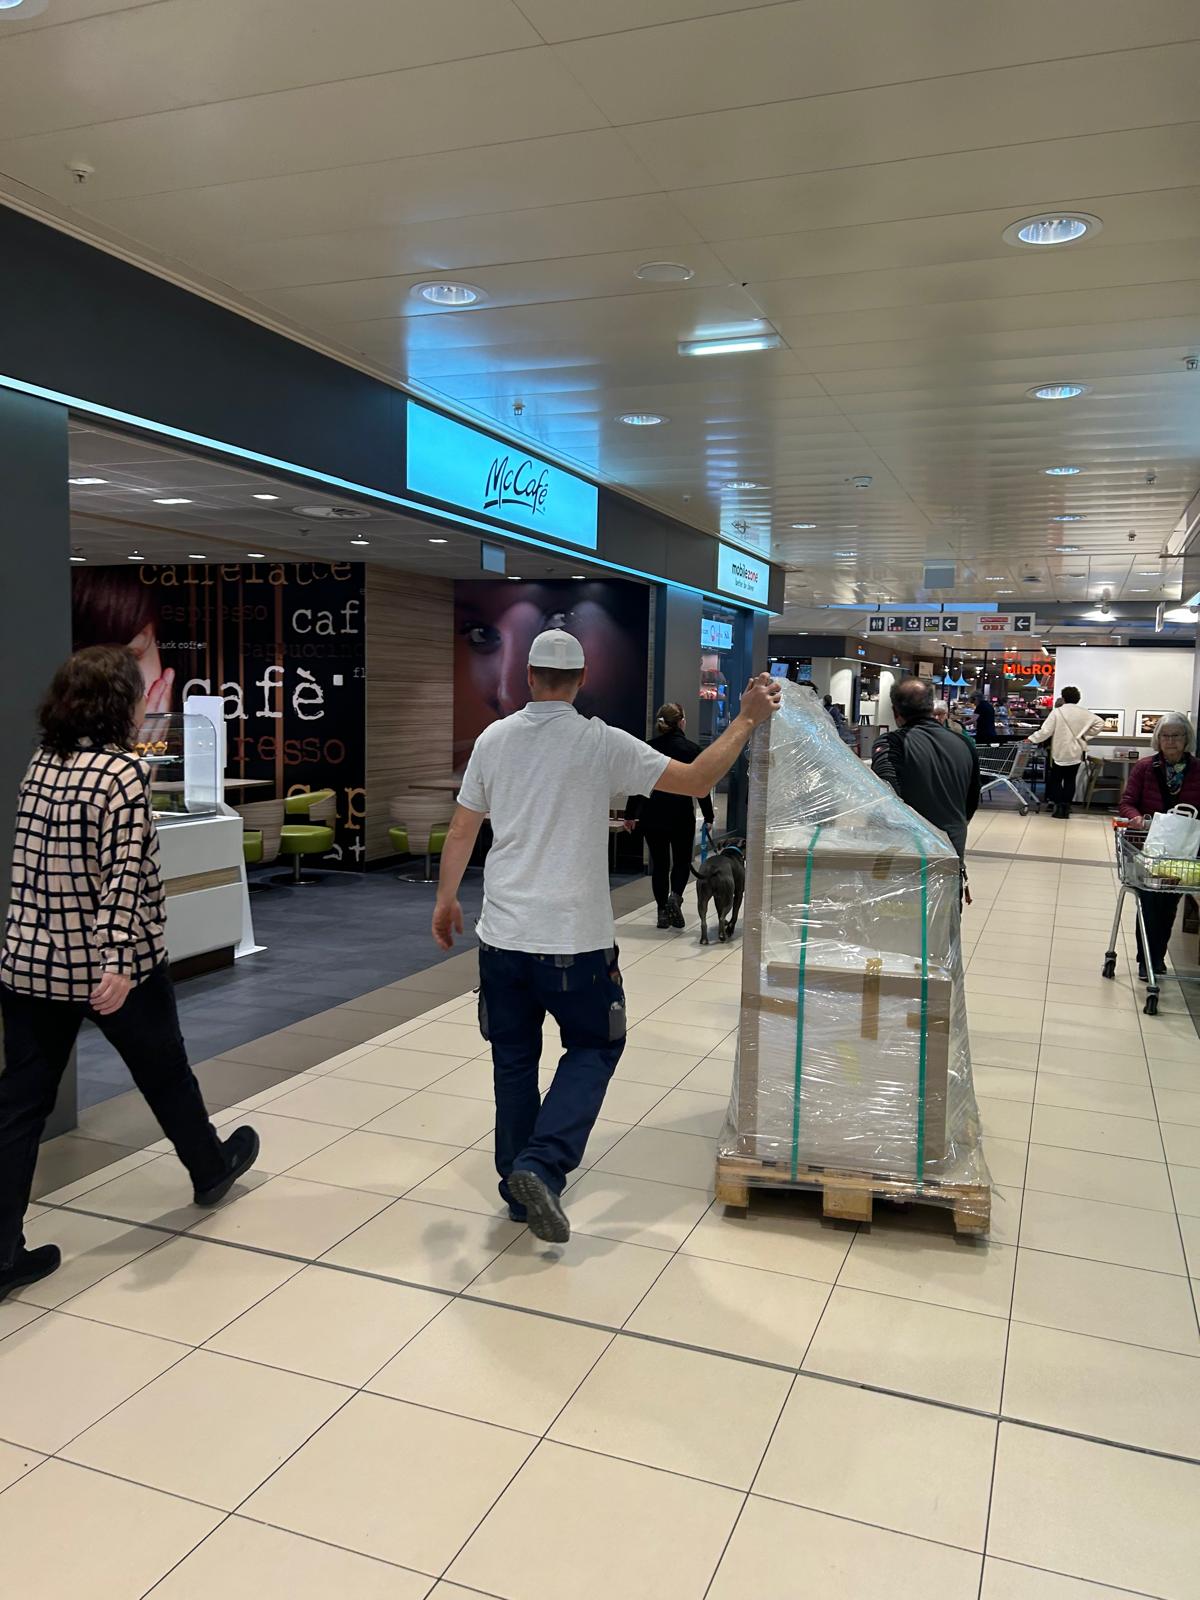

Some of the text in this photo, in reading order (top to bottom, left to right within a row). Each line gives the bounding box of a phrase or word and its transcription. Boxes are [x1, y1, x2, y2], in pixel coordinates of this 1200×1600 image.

[484, 455, 549, 515] McCafé
[731, 562, 758, 583] mobilezone
[1002, 664, 1056, 675] MIGRO
